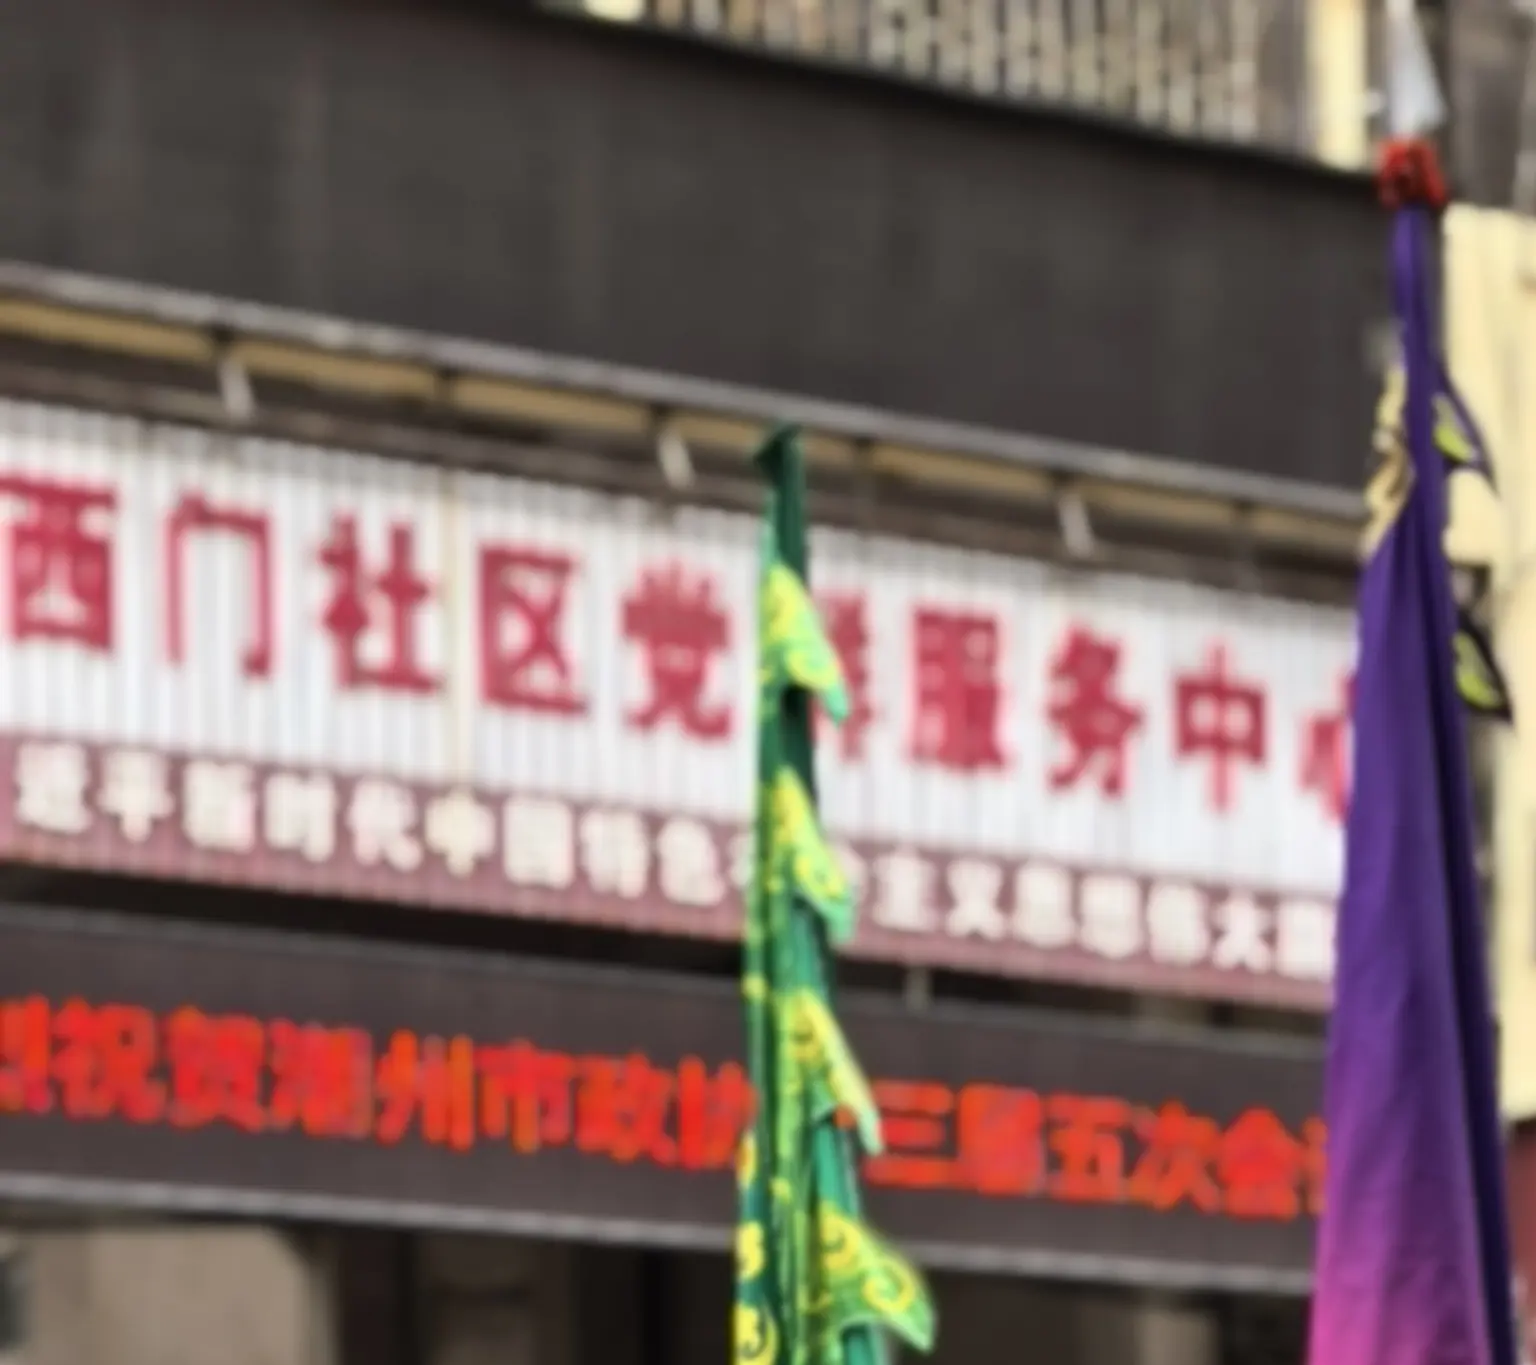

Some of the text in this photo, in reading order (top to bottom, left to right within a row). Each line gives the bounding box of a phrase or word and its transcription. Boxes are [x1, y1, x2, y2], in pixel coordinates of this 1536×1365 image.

[0, 993, 1327, 1221] 祝贺潮州市政协三届五次会
